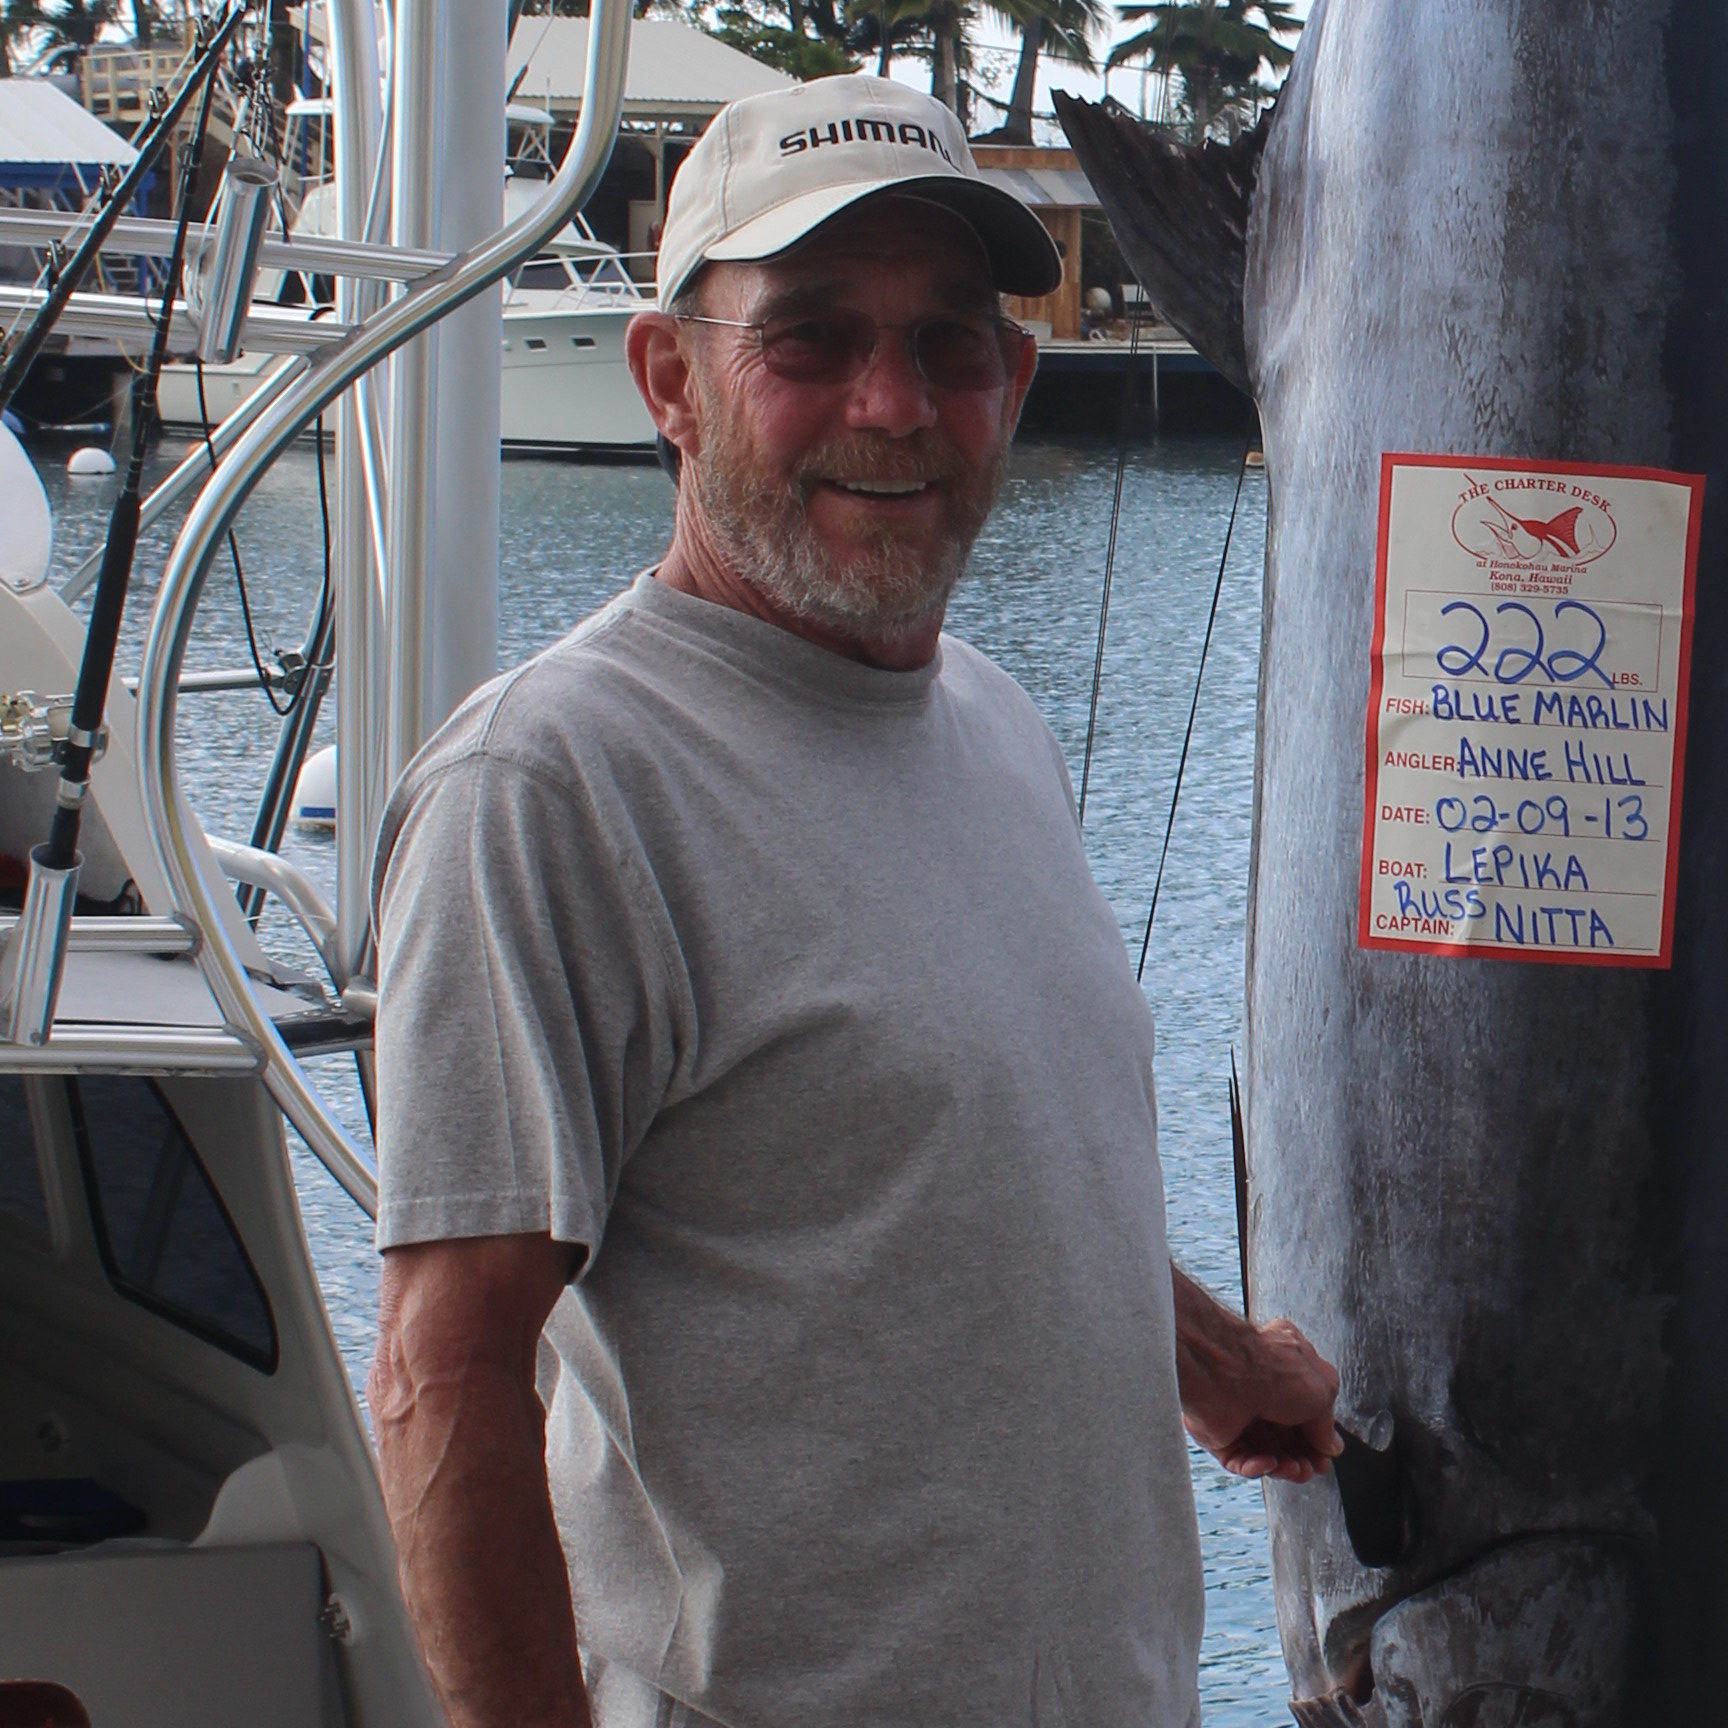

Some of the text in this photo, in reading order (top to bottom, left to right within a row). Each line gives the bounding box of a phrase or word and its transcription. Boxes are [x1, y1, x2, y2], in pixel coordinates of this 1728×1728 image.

[779, 118, 963, 173] SHIMAN
[1458, 478, 1612, 513] THE CHARTER DESK
[1476, 560, 1587, 574] at Honokohau Marina
[1528, 572, 1573, 585] Hawaii
[1491, 582, 1517, 593] (808)
[1436, 600, 1643, 690] 222 LBS.
[1386, 683, 1668, 731] FISH: BLUE MARLIN
[1384, 736, 1646, 786] ANGLER: ANNE HILL
[1381, 805, 1430, 825] DATE:
[1378, 861, 1428, 879] BOAT:
[1376, 879, 1615, 948] CAPTAIN: RUSS NITTA
